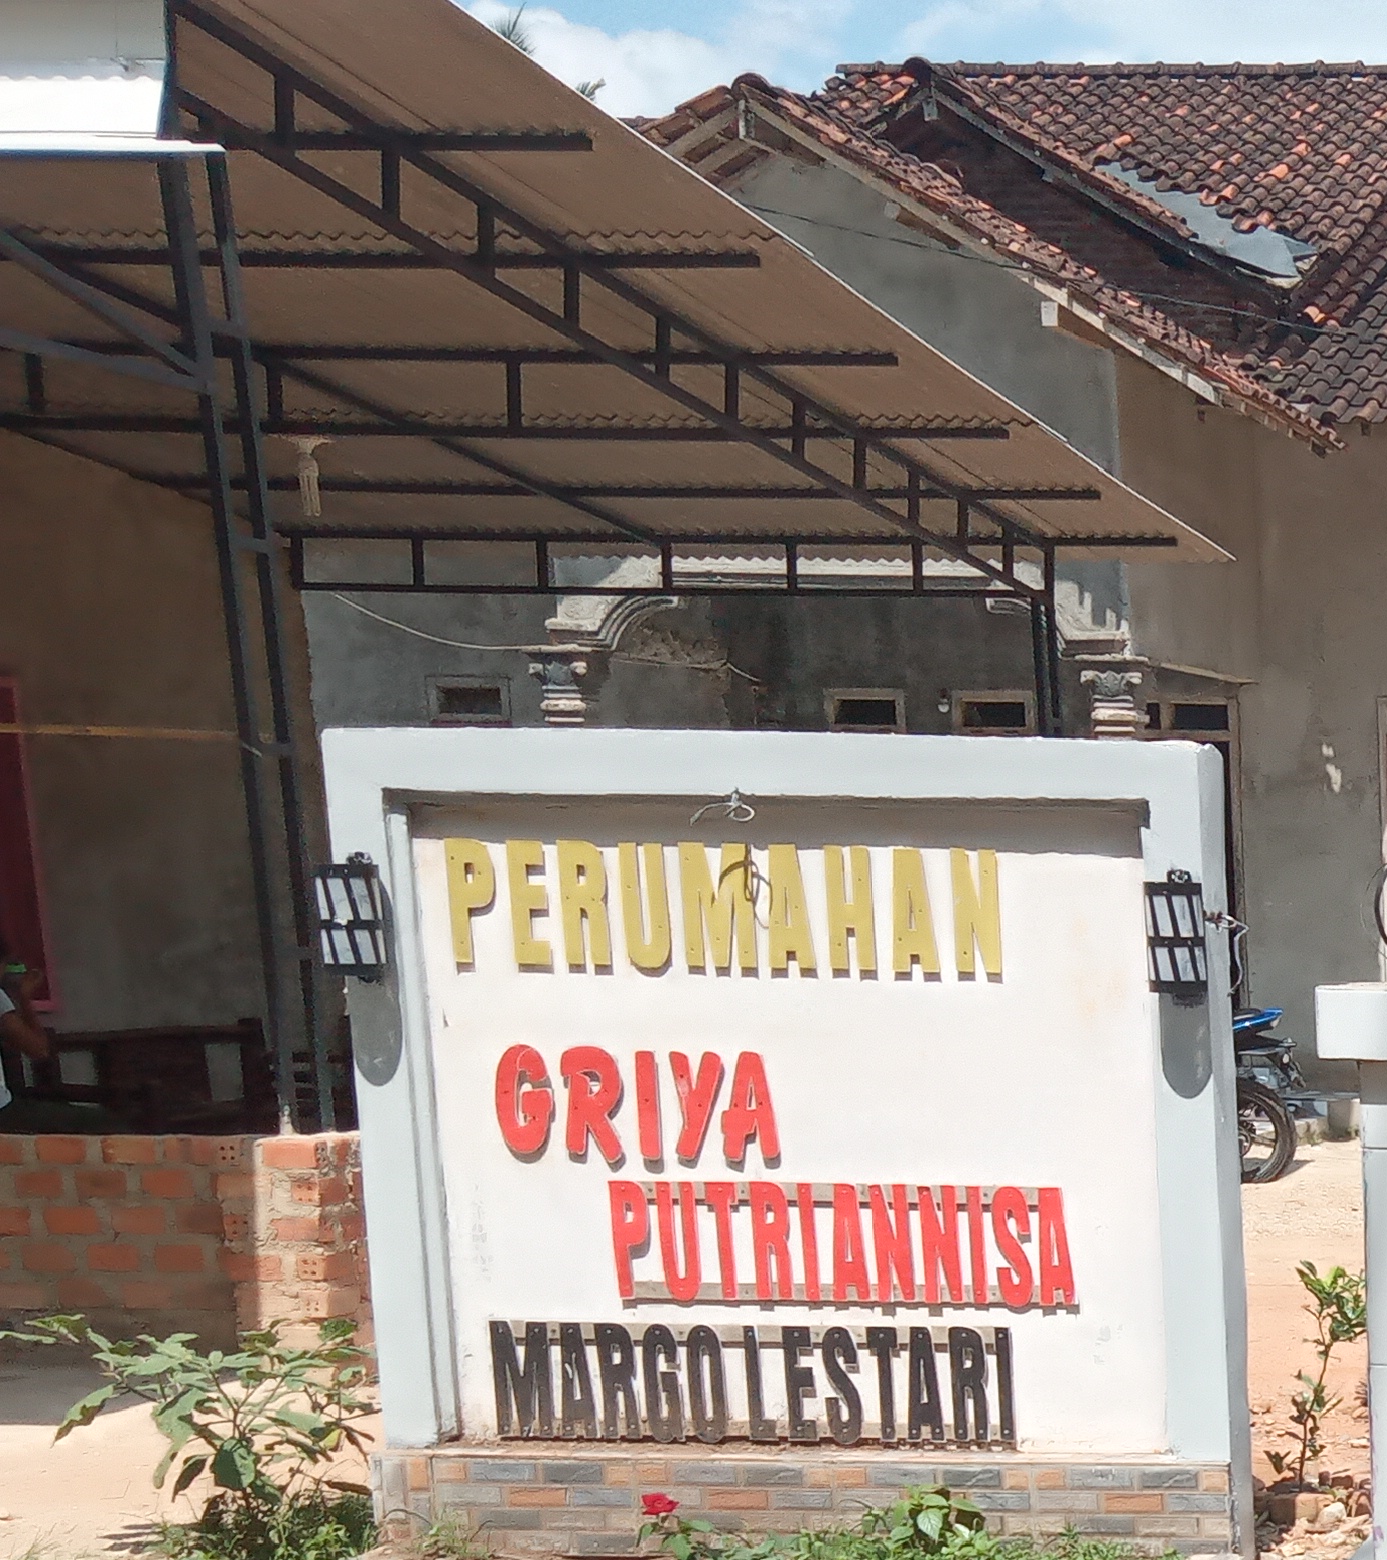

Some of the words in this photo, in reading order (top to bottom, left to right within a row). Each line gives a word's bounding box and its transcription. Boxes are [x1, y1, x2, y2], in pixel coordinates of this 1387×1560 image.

[444, 838, 1001, 976] PERUMAHAN
[495, 1043, 782, 1164] GRIYA
[607, 1180, 1077, 1307] PUTRIANNISA
